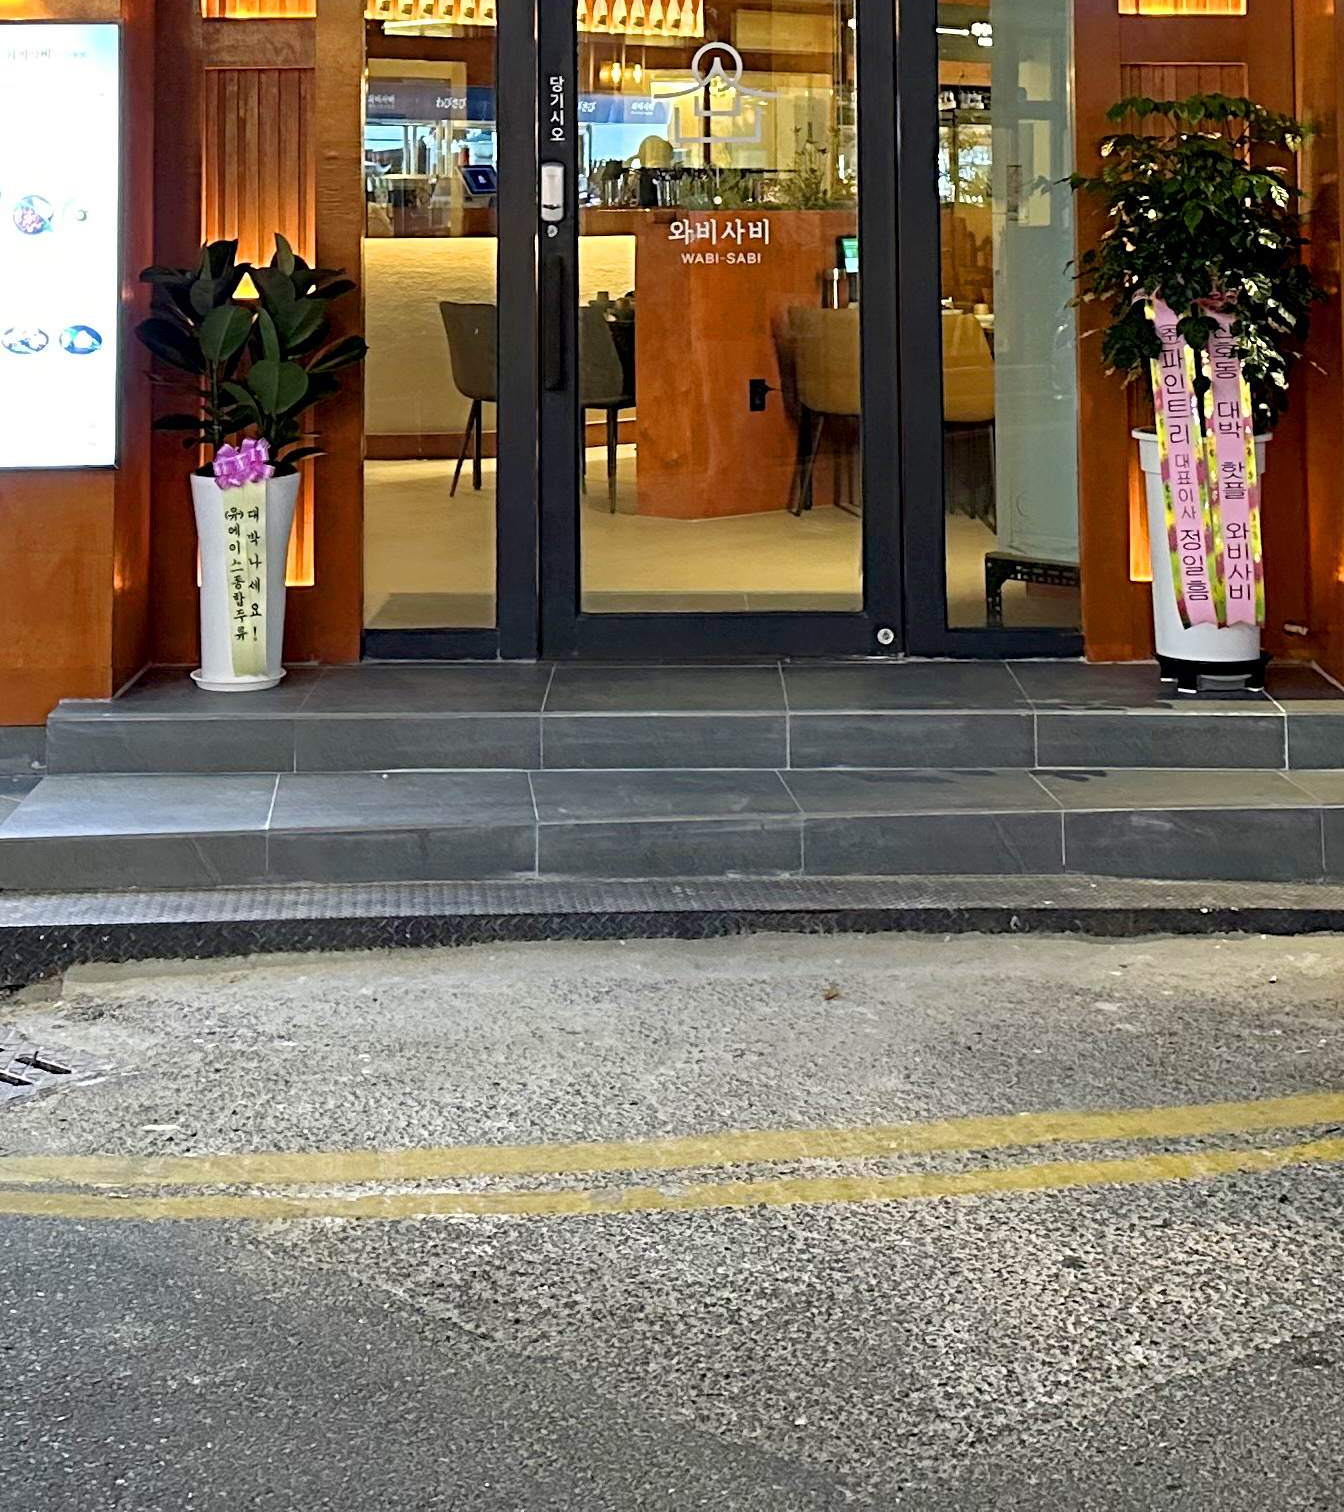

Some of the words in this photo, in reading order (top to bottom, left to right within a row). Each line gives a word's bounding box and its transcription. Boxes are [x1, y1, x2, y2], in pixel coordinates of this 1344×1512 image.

[549, 75, 566, 142] 당기시오
[668, 218, 770, 245] 와비사비
[680, 252, 762, 264] WABI-SABI
[1217, 401, 1243, 439] 대박
[1174, 453, 1197, 520] 대표이사
[1220, 461, 1246, 500] 핫플
[247, 506, 263, 642] 대박나세요!
[1226, 522, 1253, 601] 와비사비
